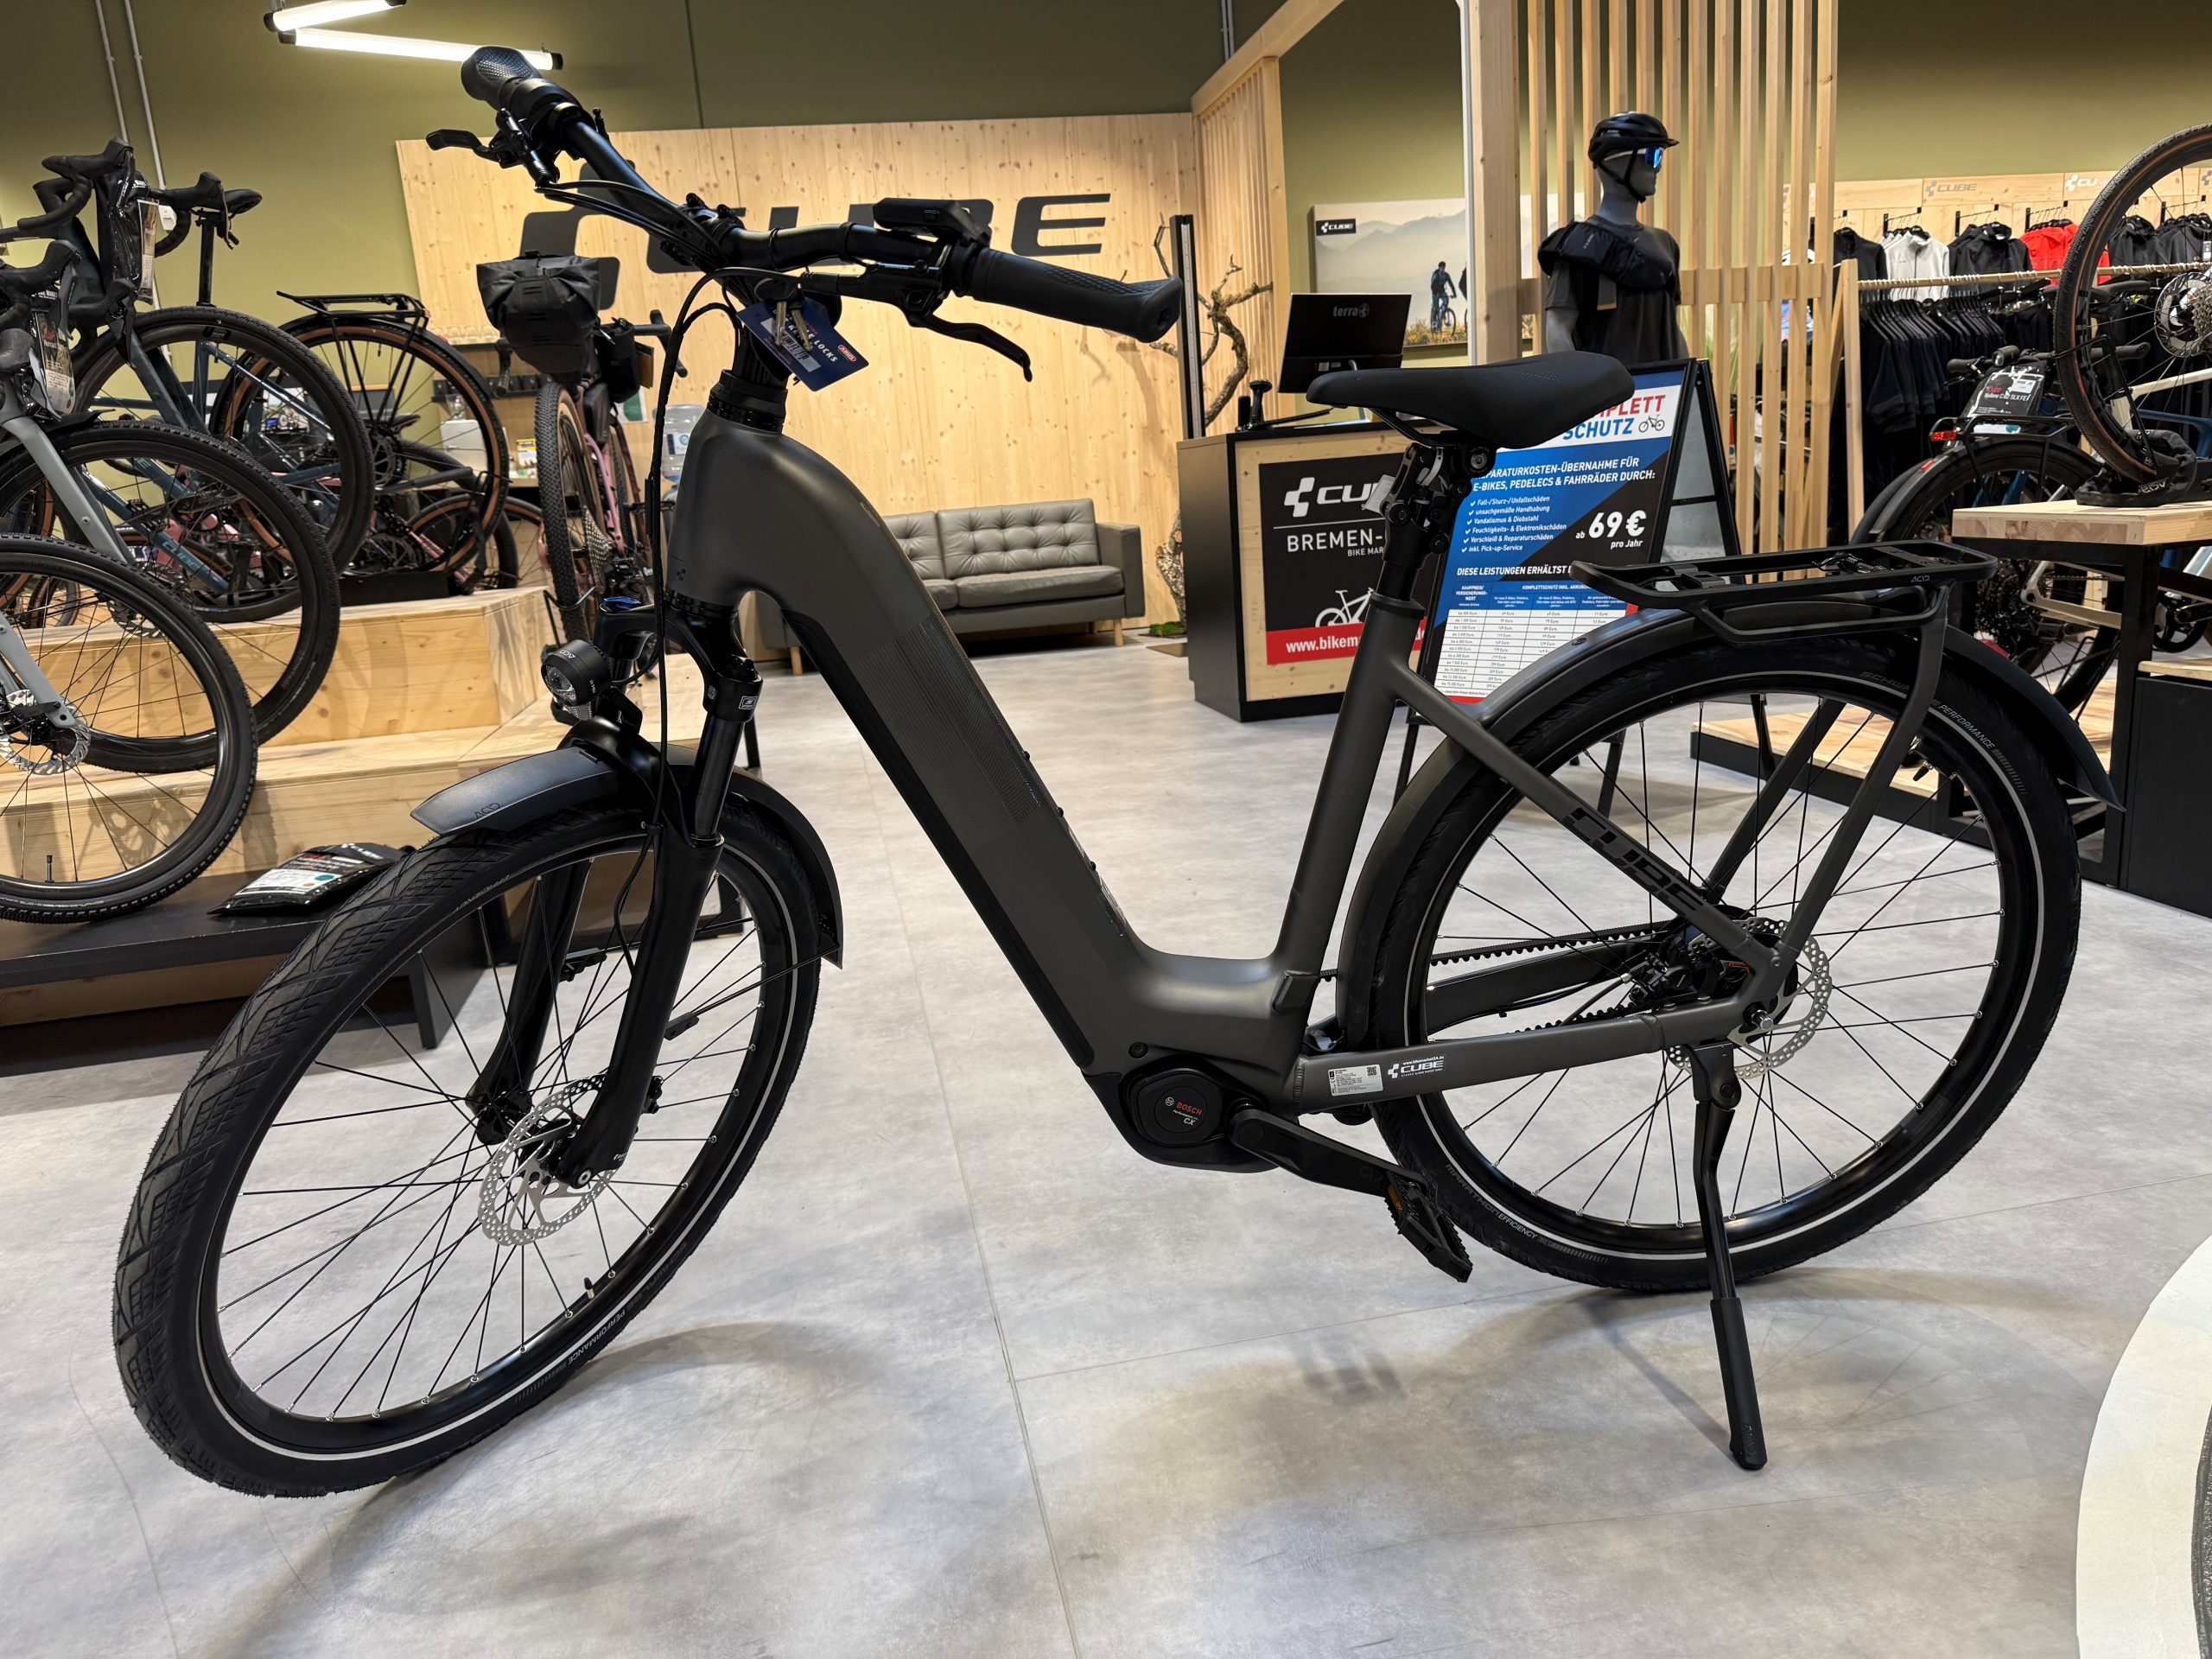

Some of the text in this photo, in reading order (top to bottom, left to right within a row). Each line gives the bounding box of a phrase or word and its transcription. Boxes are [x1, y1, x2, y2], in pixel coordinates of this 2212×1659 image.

[1936, 182, 1978, 193] CUBE
[2077, 177, 2108, 188] CU
[1332, 304, 1358, 317] terra
[814, 339, 838, 363] LOCKS
[1562, 417, 1635, 441] SCHUTZ
[1476, 456, 1639, 480] PARATURKOSTEN-ÜBERNAHME FÜR
[1473, 469, 1656, 492] E-BIKES, PEDELECS & FAHRRÄDER DURCH:
[1316, 482, 1379, 505] CU
[1516, 505, 1550, 514] Handhabung
[1473, 516, 1507, 524] Vandalismus
[1516, 523, 1567, 531] Elektronikschäden
[1575, 510, 1647, 540] ab 69 €
[1287, 528, 1383, 553] BREMEN-
[1471, 536, 1498, 544] Verschleiß
[1503, 533, 1554, 543] Reparaturschäden
[1611, 538, 1643, 550] pro Jahr
[1347, 548, 1366, 557] BIKE
[1481, 544, 1523, 554] Pick-up-Service
[1457, 567, 1478, 576] DIESE
[1479, 566, 1527, 575] LEISTUNGEN
[1527, 563, 1567, 575] ERHÄLTST
[1286, 633, 1361, 654] www.bikem
[1938, 703, 1996, 749] PERFORMANCE
[1560, 807, 1704, 912] CUBE
[1400, 1059, 1445, 1074] CUBE
[1176, 1101, 1203, 1116] BOSCH
[1183, 1117, 1196, 1126] CX
[1498, 1212, 1539, 1240] EFFICIENCY
[568, 1308, 626, 1366] PERFORMANCE
